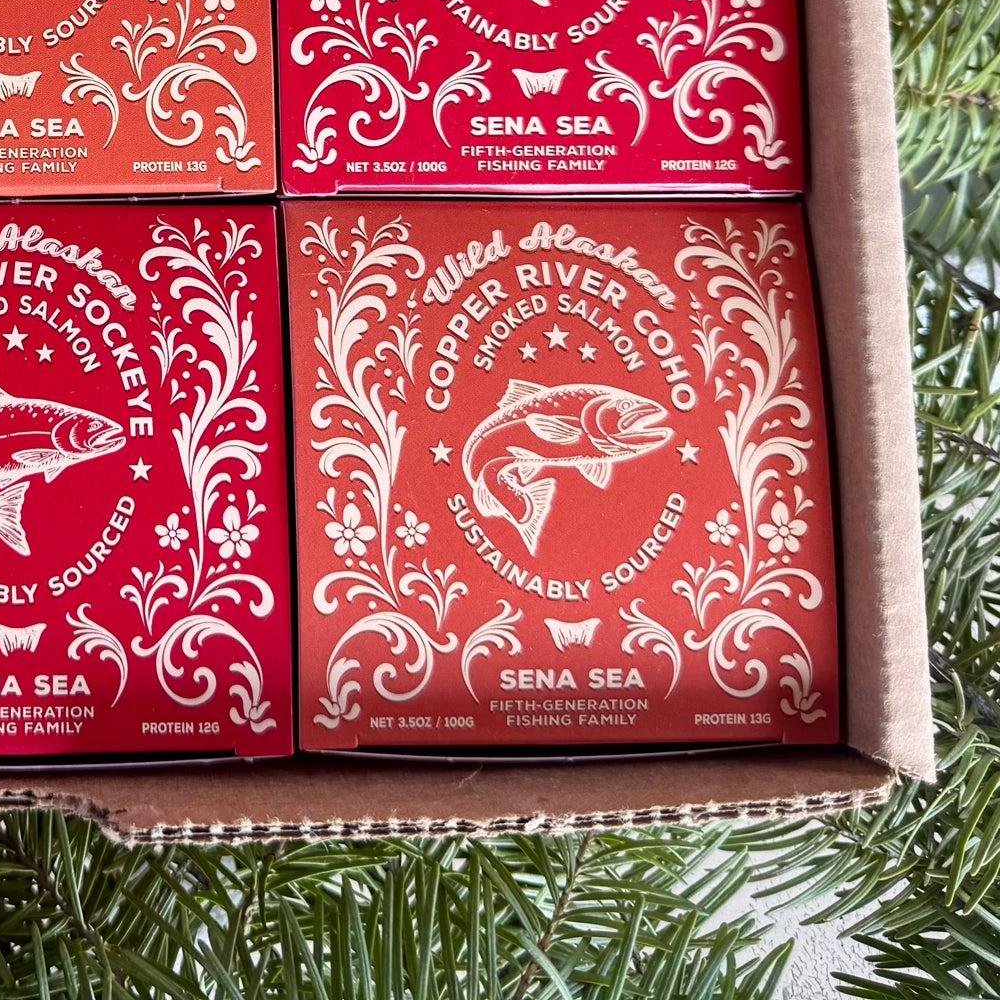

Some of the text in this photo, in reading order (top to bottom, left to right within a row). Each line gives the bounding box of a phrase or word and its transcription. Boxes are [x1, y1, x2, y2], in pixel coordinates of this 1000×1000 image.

[30, 117, 85, 138] SEA
[470, 115, 613, 136] SENA SEA
[461, 144, 617, 157] FIFTH-GENERATION
[21, 161, 78, 173] FAMILY
[133, 160, 208, 172] PROTEIN 13G
[346, 161, 370, 173] NET
[373, 161, 407, 173] 3.5OZ
[417, 161, 447, 173] 100G
[477, 159, 605, 172] FISHING FAMILY
[422, 221, 677, 310] Wild Alaskan
[18, 295, 101, 372] SALMON
[425, 261, 697, 411] COPPER RIVER COHO
[473, 293, 645, 371] SMOKED SALMON
[66, 283, 154, 437] SOCKEYE
[48, 495, 135, 597] SOURCED
[447, 492, 686, 600] SUSTAINABLY SOURCED
[34, 674, 91, 696] SEA
[500, 667, 645, 690] SENA SEA
[490, 698, 648, 712] FIFTH-GENERATION
[24, 721, 83, 735] FAMILY
[141, 721, 220, 734] PROTEIN 12G
